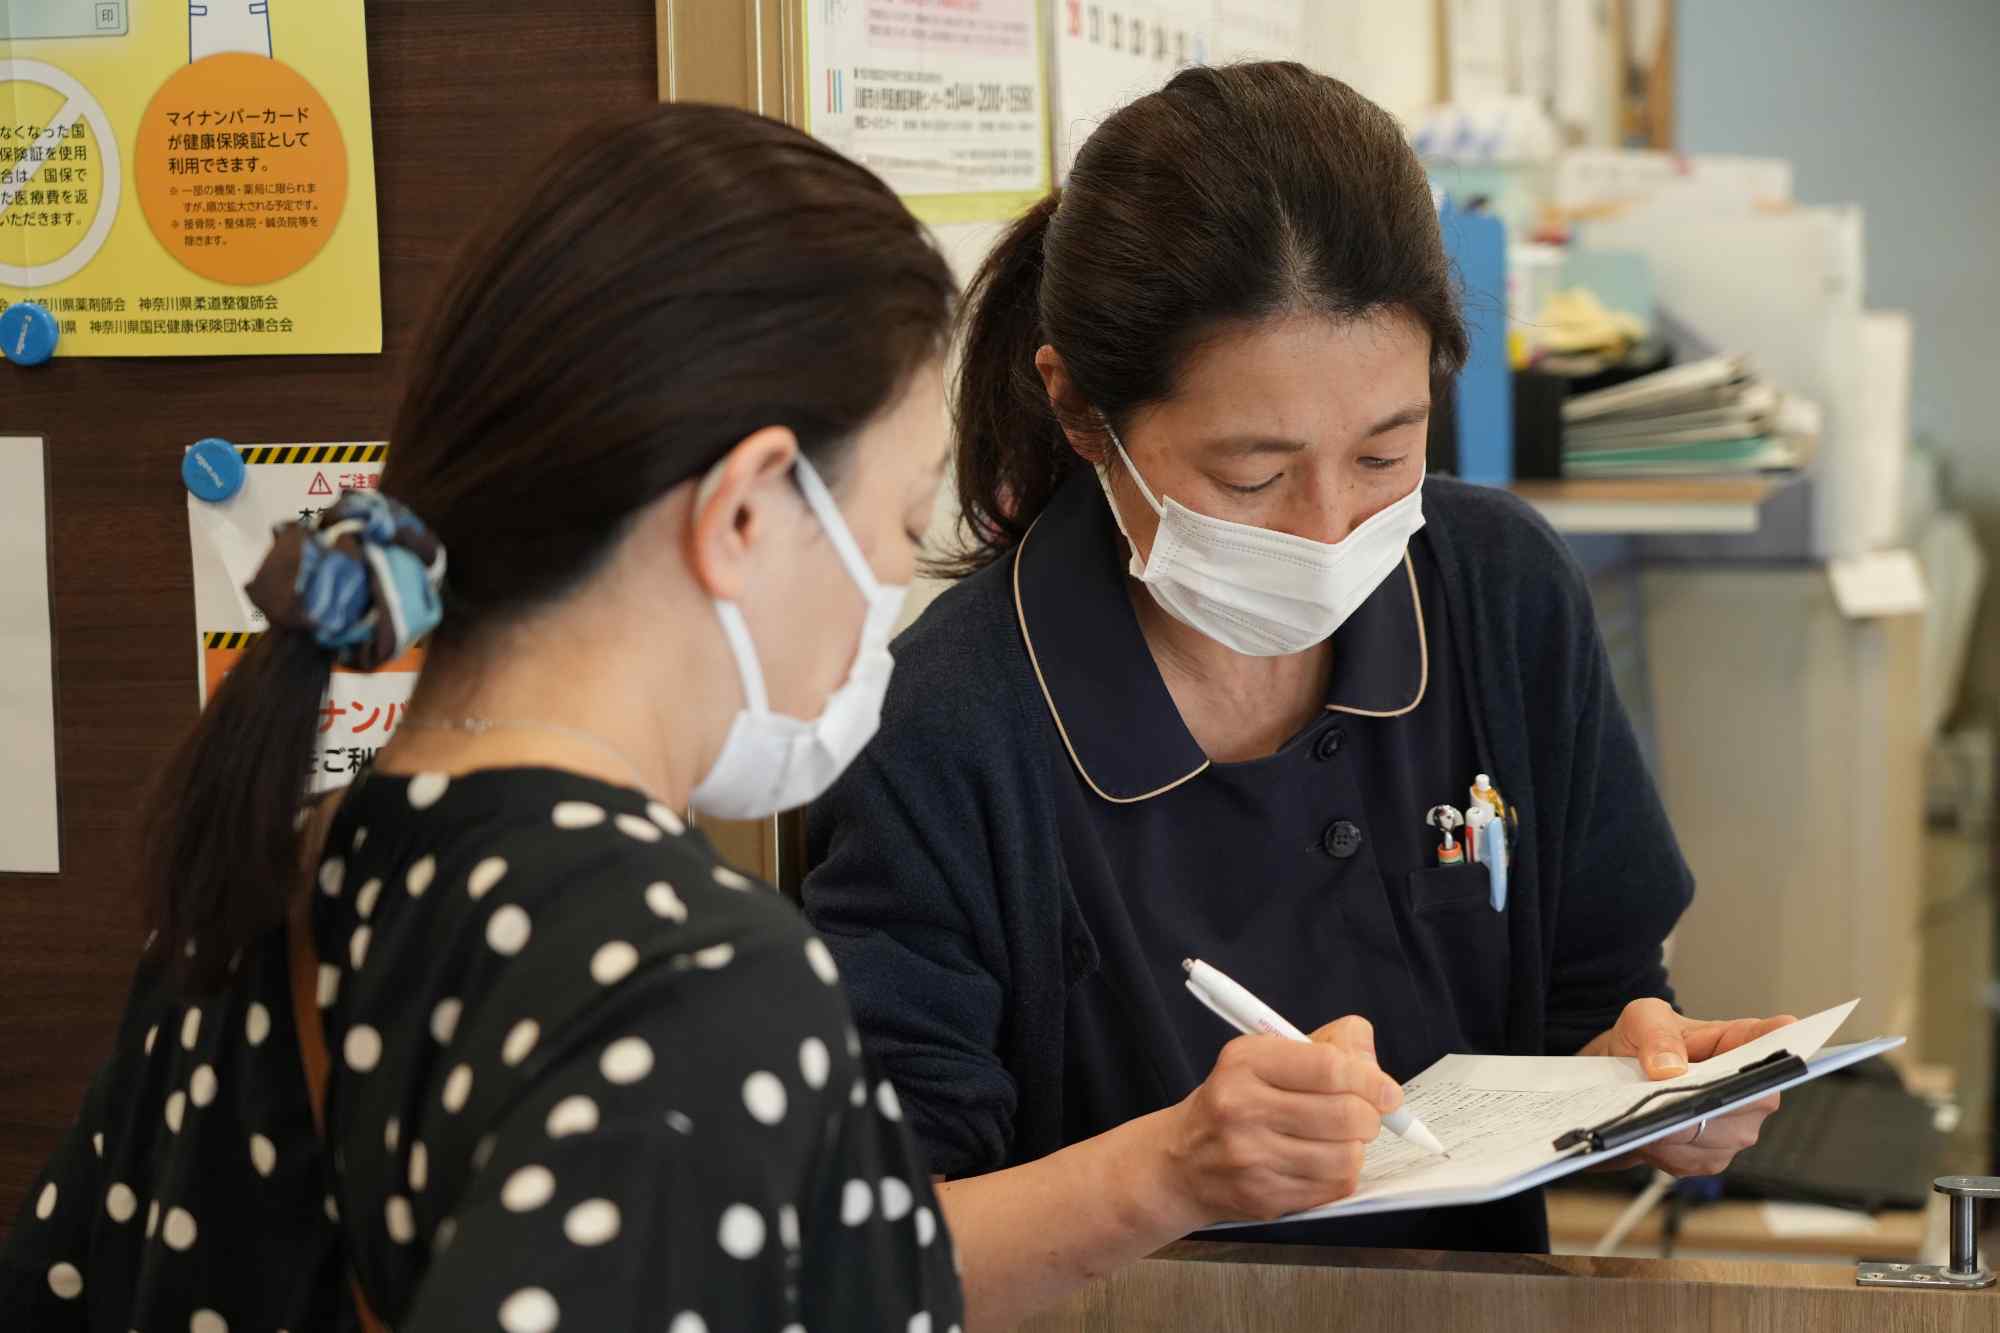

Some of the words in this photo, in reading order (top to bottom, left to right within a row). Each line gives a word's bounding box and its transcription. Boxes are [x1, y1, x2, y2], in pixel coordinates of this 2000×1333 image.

[166, 107, 309, 126] マイナンバーカード
[0, 124, 85, 139] なくなった国
[168, 131, 310, 151] が健康保険証として
[0, 145, 87, 161] 保険証を使用
[168, 156, 269, 175] 利用できます。
[0, 168, 87, 183] 合は、国保で
[0, 189, 88, 205] た医療費を返
[139, 295, 279, 311] 神奈川県柔道整復師会
[89, 317, 293, 335] 神奈川県国民健康保険団体連合会
